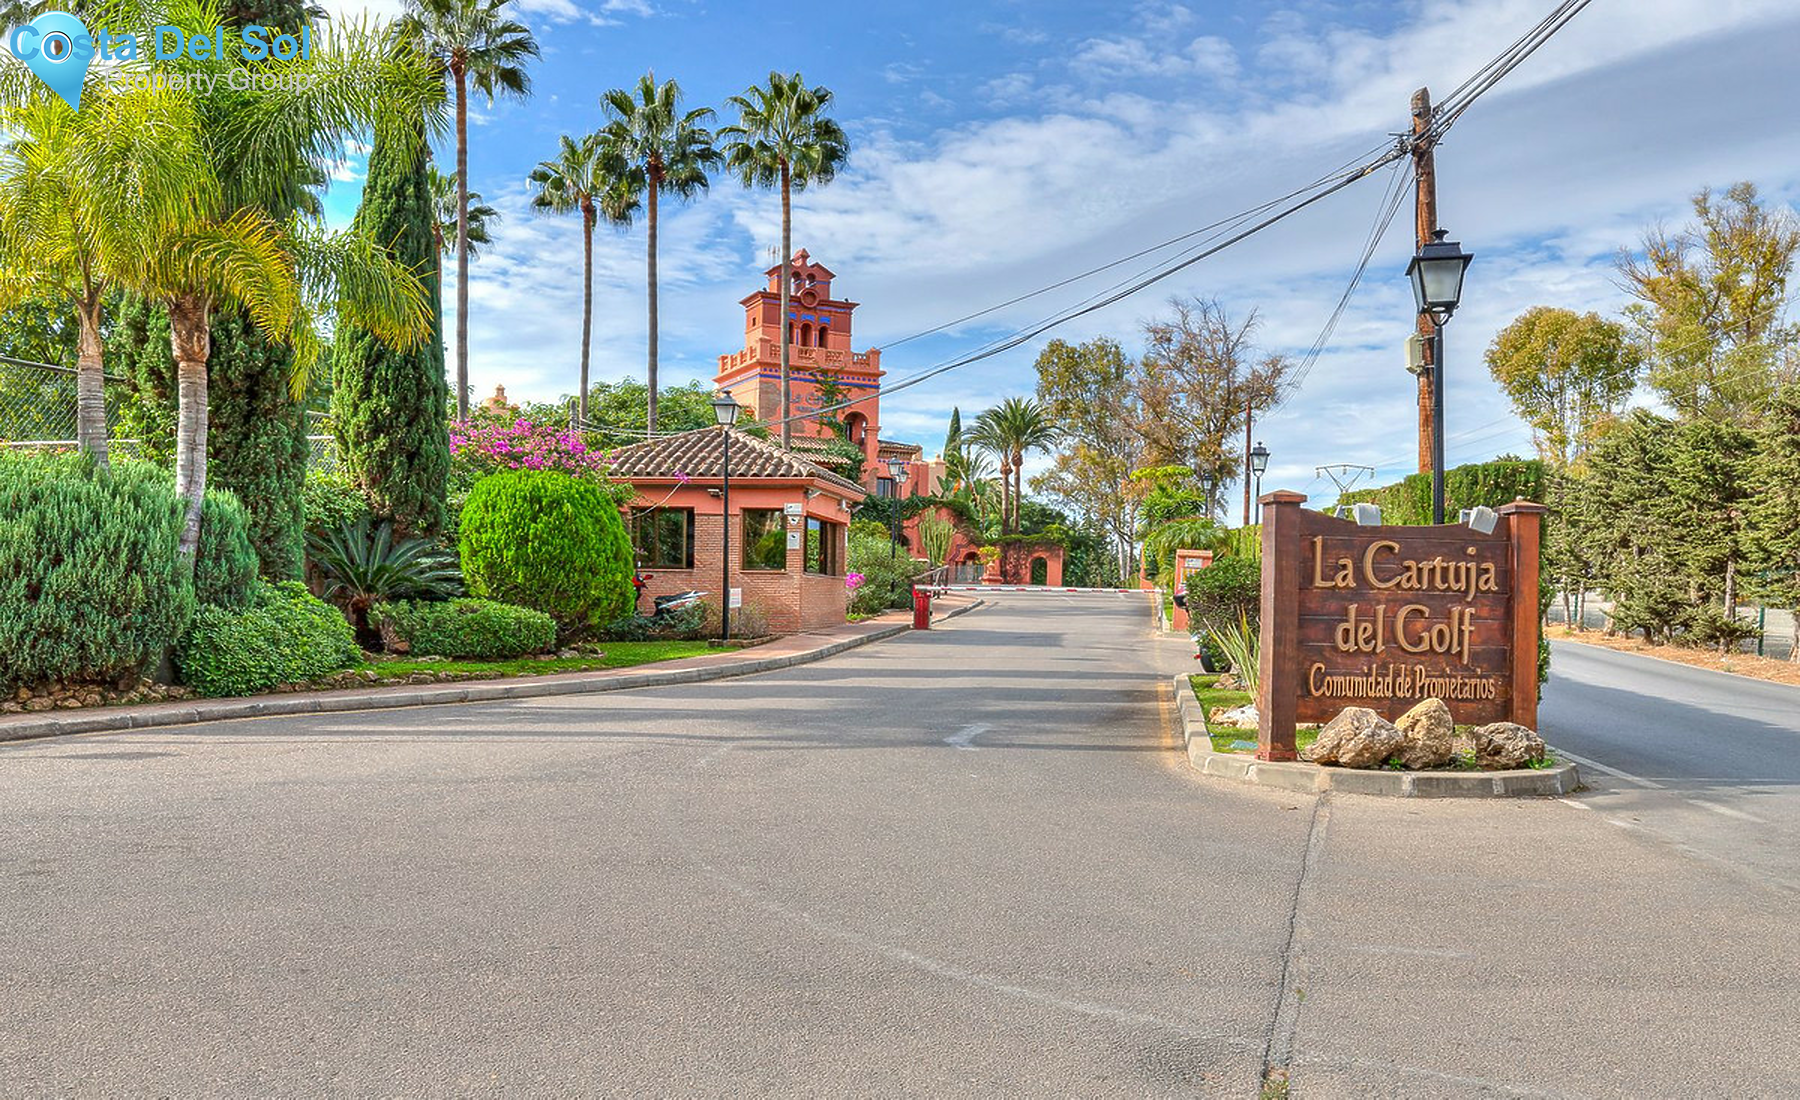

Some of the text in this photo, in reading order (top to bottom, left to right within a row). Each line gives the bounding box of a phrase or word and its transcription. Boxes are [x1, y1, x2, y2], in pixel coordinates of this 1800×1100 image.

[1312, 536, 1498, 601] La Cartuja
[1336, 604, 1475, 665] del Golf
[1310, 663, 1495, 699] Comunidad de Propietarios
